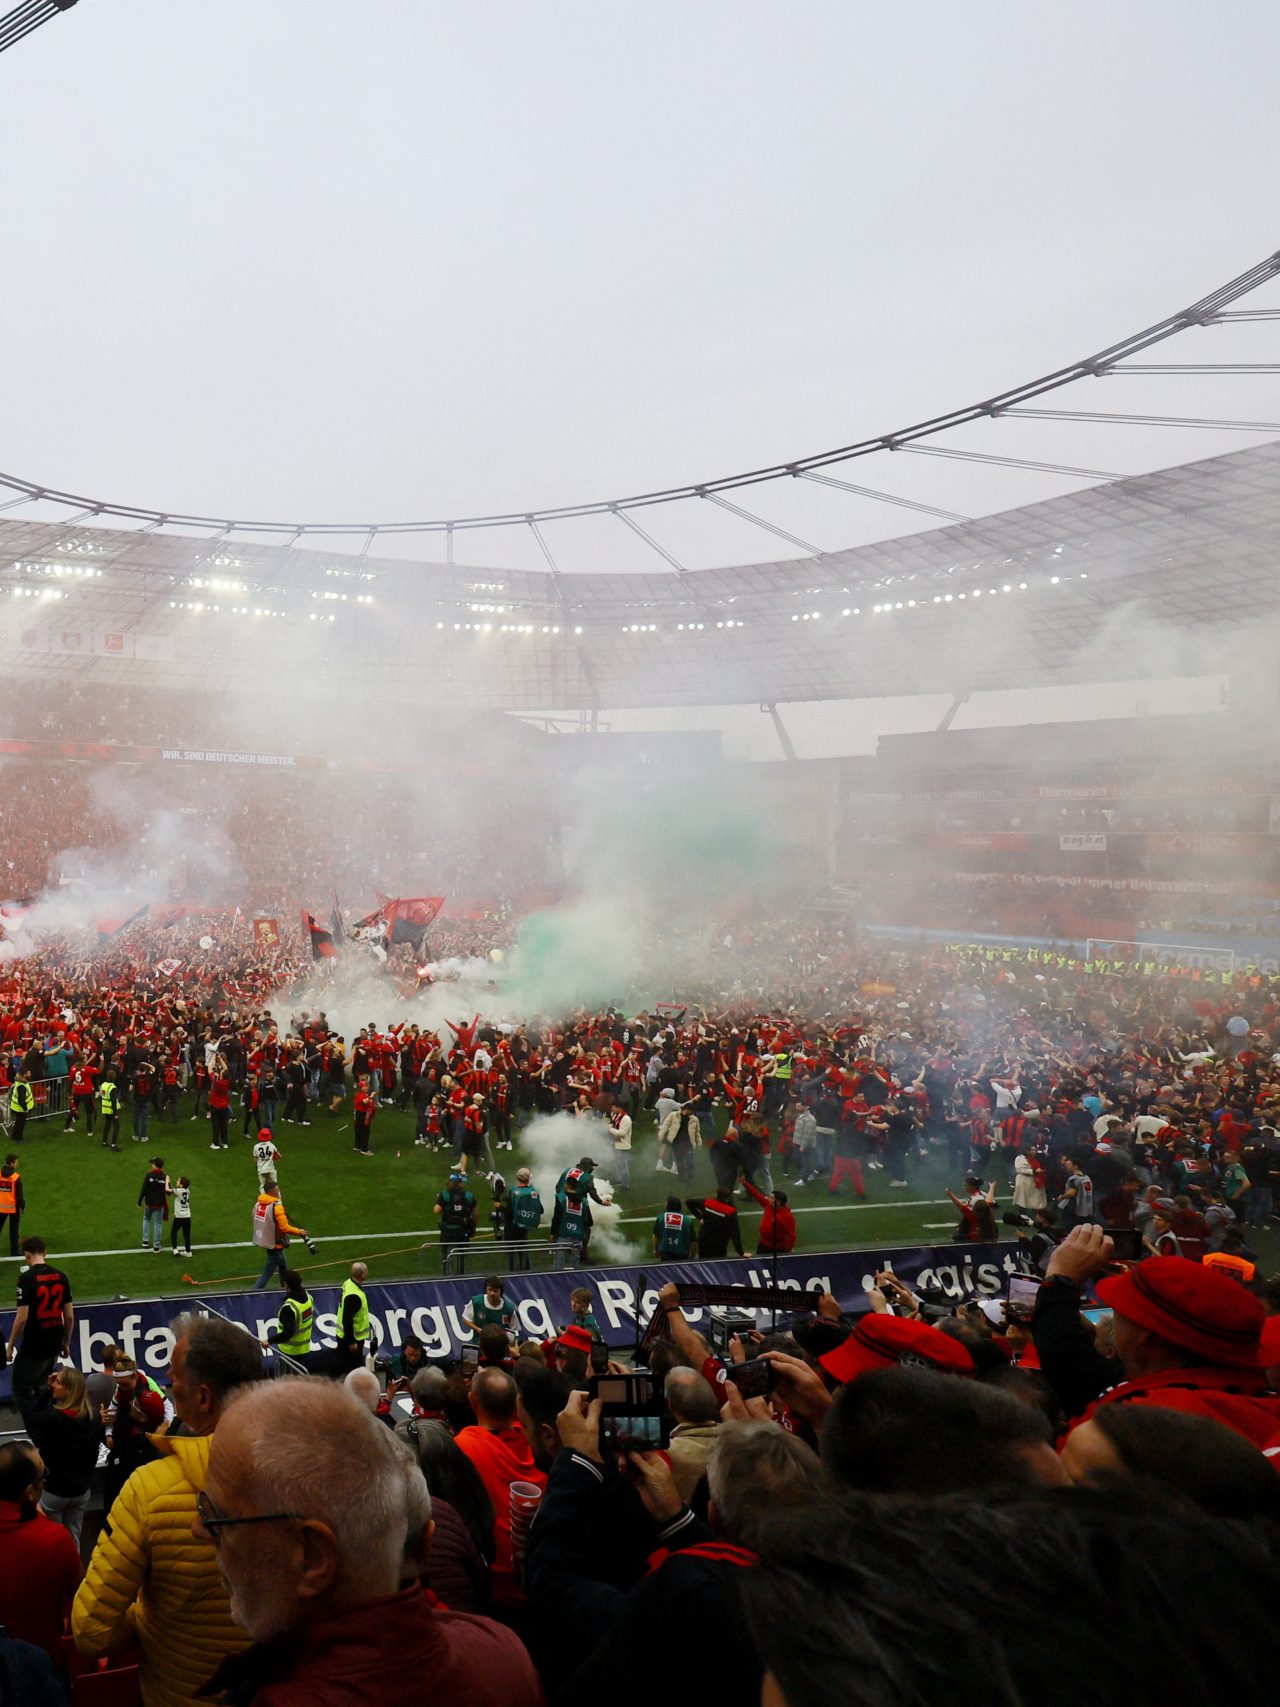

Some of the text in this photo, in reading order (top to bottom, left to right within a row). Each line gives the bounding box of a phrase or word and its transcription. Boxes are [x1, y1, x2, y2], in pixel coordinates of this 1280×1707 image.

[162, 750, 296, 767] WIR. SIND DEUTSCHER MEISTER.
[566, 1221, 577, 1231] 09
[36, 1284, 65, 1319] 22
